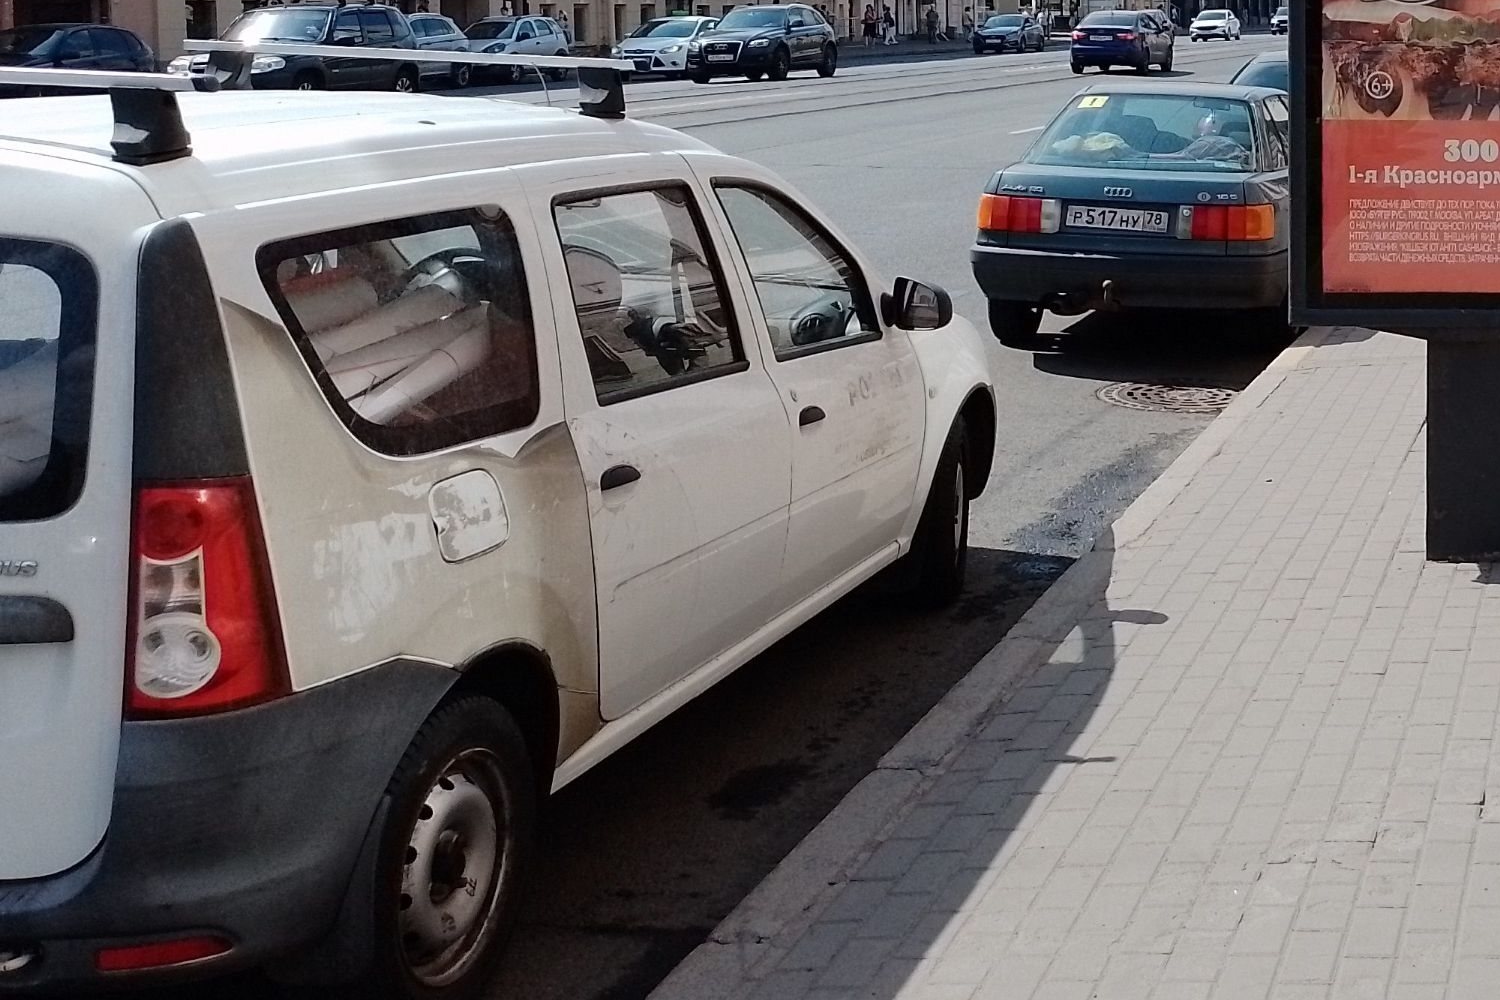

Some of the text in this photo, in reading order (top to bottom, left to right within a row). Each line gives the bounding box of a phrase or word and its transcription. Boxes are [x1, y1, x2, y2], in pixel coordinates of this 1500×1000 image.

[1371, 77, 1391, 94] 6+
[1443, 139, 1499, 163] 300
[1349, 165, 1378, 184] 1-я
